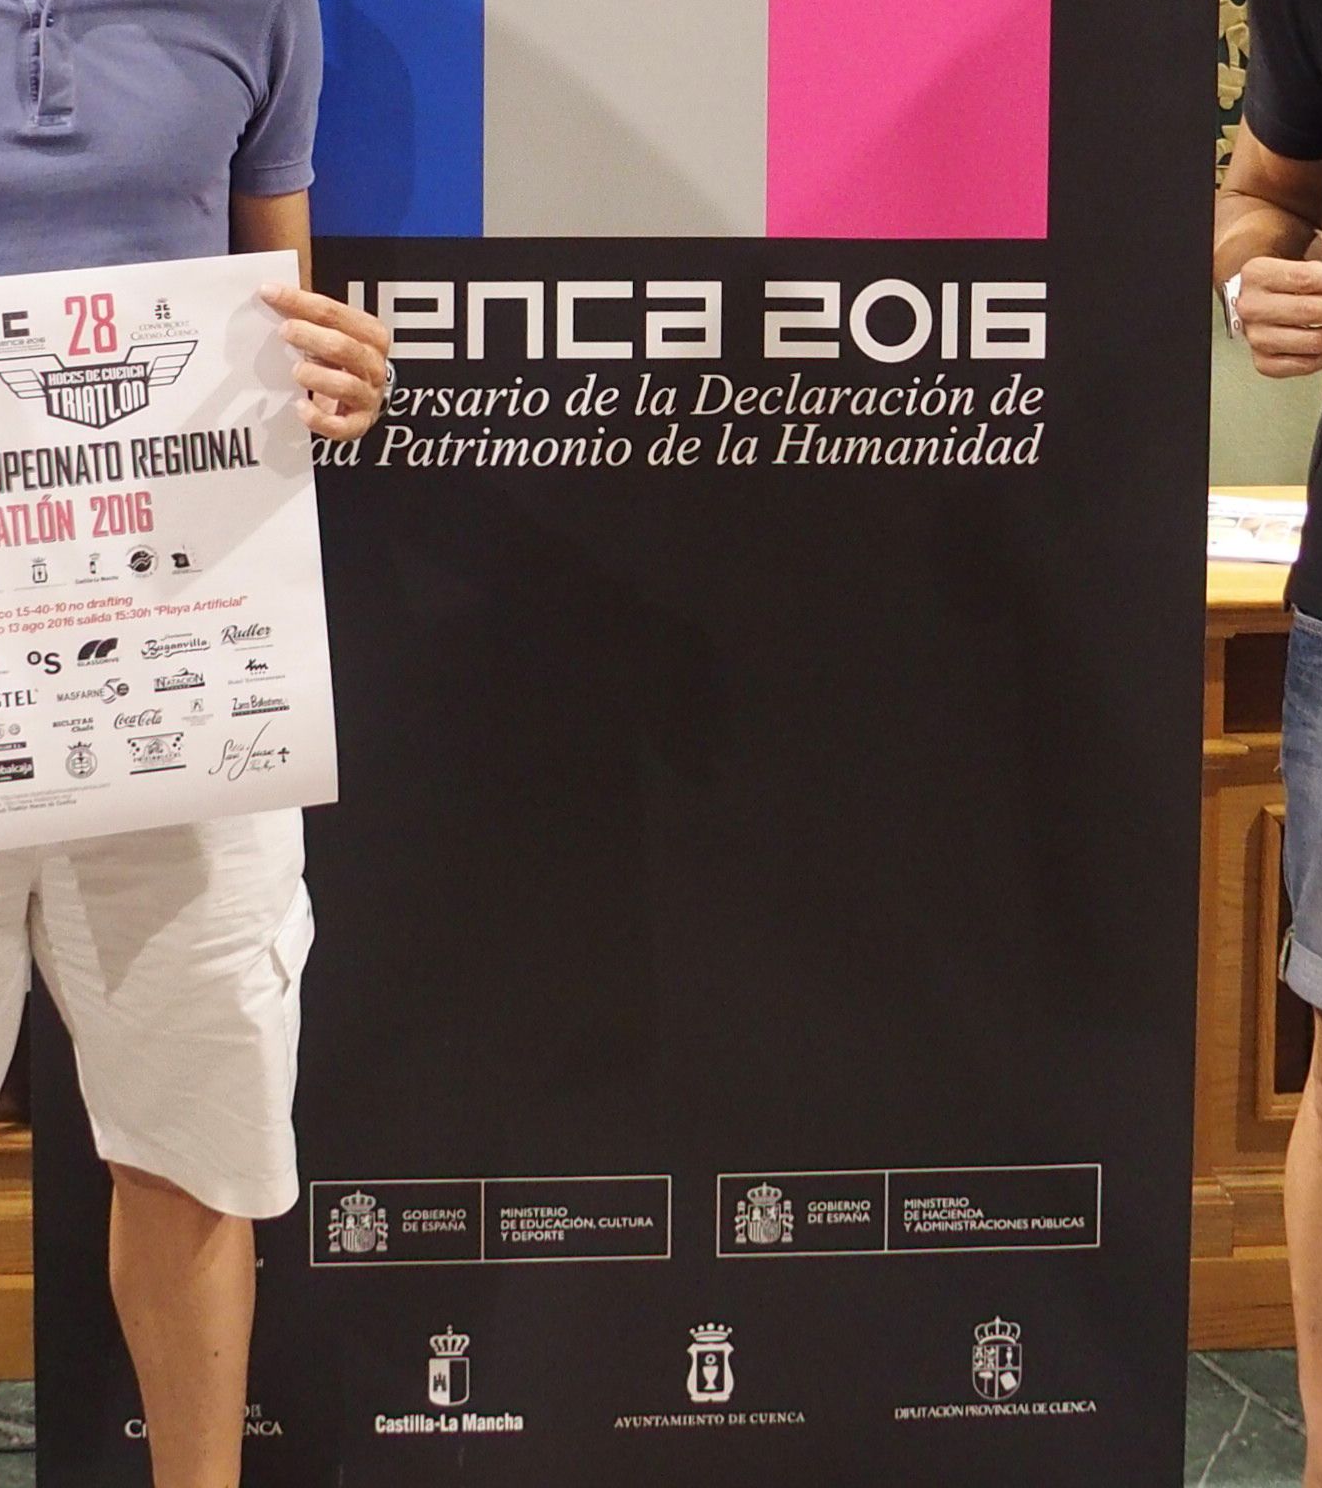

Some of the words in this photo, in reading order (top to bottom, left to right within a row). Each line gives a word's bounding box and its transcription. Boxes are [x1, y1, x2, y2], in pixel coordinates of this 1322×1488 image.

[65, 293, 118, 356] 28
[348, 280, 722, 360] enca
[764, 278, 1047, 362] 2016
[48, 370, 84, 386] HOCES
[86, 368, 101, 383] DE
[101, 365, 145, 381] CUENCA
[49, 379, 146, 426] TRIATLÓN
[387, 376, 550, 417] ersario
[565, 373, 619, 417] de
[635, 373, 679, 417] la
[690, 372, 974, 416] Declaración
[989, 373, 1044, 416] de
[130, 427, 260, 479] REGIONAL
[375, 425, 632, 467] Patrimonio
[647, 423, 701, 466] de
[717, 422, 758, 465] la
[772, 422, 1044, 465] Humanidad
[90, 491, 155, 538] 2016
[68, 601, 84, 611] no
[86, 595, 133, 610] drafting
[8, 622, 19, 633] 13
[21, 621, 44, 634] ago
[47, 616, 75, 629] 2016
[76, 611, 112, 625] salida
[115, 607, 151, 620] 15:30h
[808, 1200, 871, 1212] GOBIERNO
[904, 1197, 970, 1210] MINISTERIO
[403, 1209, 467, 1221] GOBIERNO
[500, 1207, 568, 1219] MINISTERIO
[808, 1212, 823, 1224] DE
[826, 1209, 871, 1223] ESPAÑA
[904, 1210, 920, 1221] DE
[922, 1208, 984, 1220] HACIENDA
[403, 1221, 419, 1233] DE
[421, 1218, 467, 1232] ESPAÑA
[500, 1219, 518, 1231] DE
[599, 1216, 654, 1228] CULTURA
[904, 1221, 912, 1233] Y
[914, 1218, 1029, 1232] ADMINISTRACIONES
[1031, 1216, 1086, 1230] PÚBLICAS
[500, 1230, 508, 1242] Y
[511, 1229, 566, 1241] DEPORTE
[894, 1404, 964, 1420] DIPUTACIÓN
[965, 1402, 1030, 1417] PROVINCIAL
[1032, 1402, 1048, 1415] DE
[1049, 1400, 1097, 1414] CUENCA
[375, 1414, 459, 1433] Castilla-La
[462, 1412, 524, 1432] Mancha
[614, 1414, 725, 1429] AYUNTAMIENTO
[728, 1413, 746, 1426] DE
[749, 1411, 806, 1425] CUENCA
